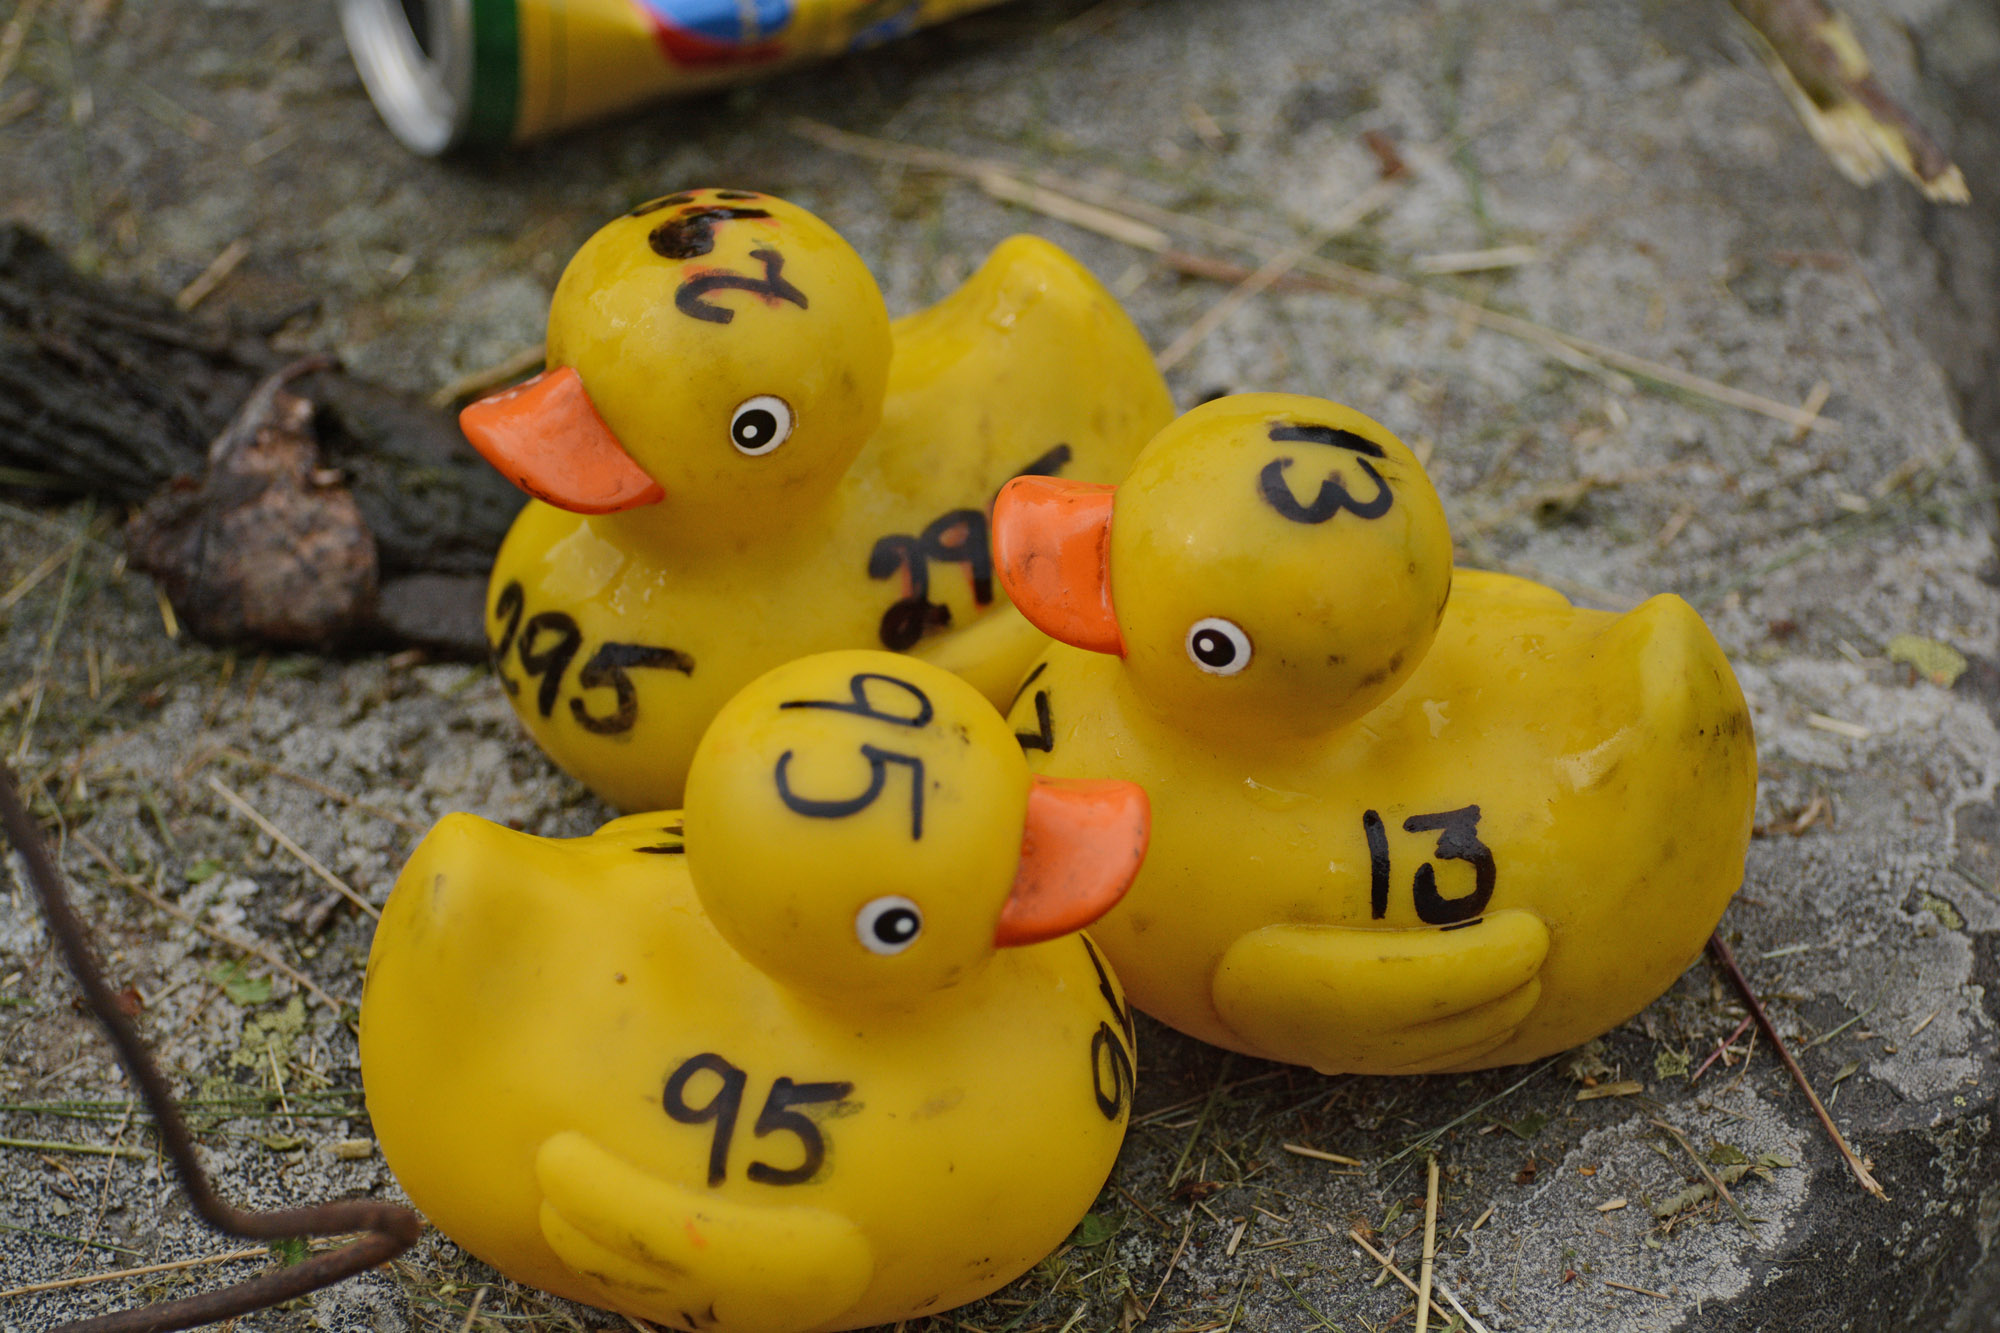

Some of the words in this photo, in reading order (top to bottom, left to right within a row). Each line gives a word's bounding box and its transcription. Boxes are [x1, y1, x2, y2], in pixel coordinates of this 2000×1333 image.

[1259, 423, 1394, 525] 13
[775, 673, 933, 841] 95
[1363, 804, 1497, 931] 13
[662, 1053, 856, 1187] 95
